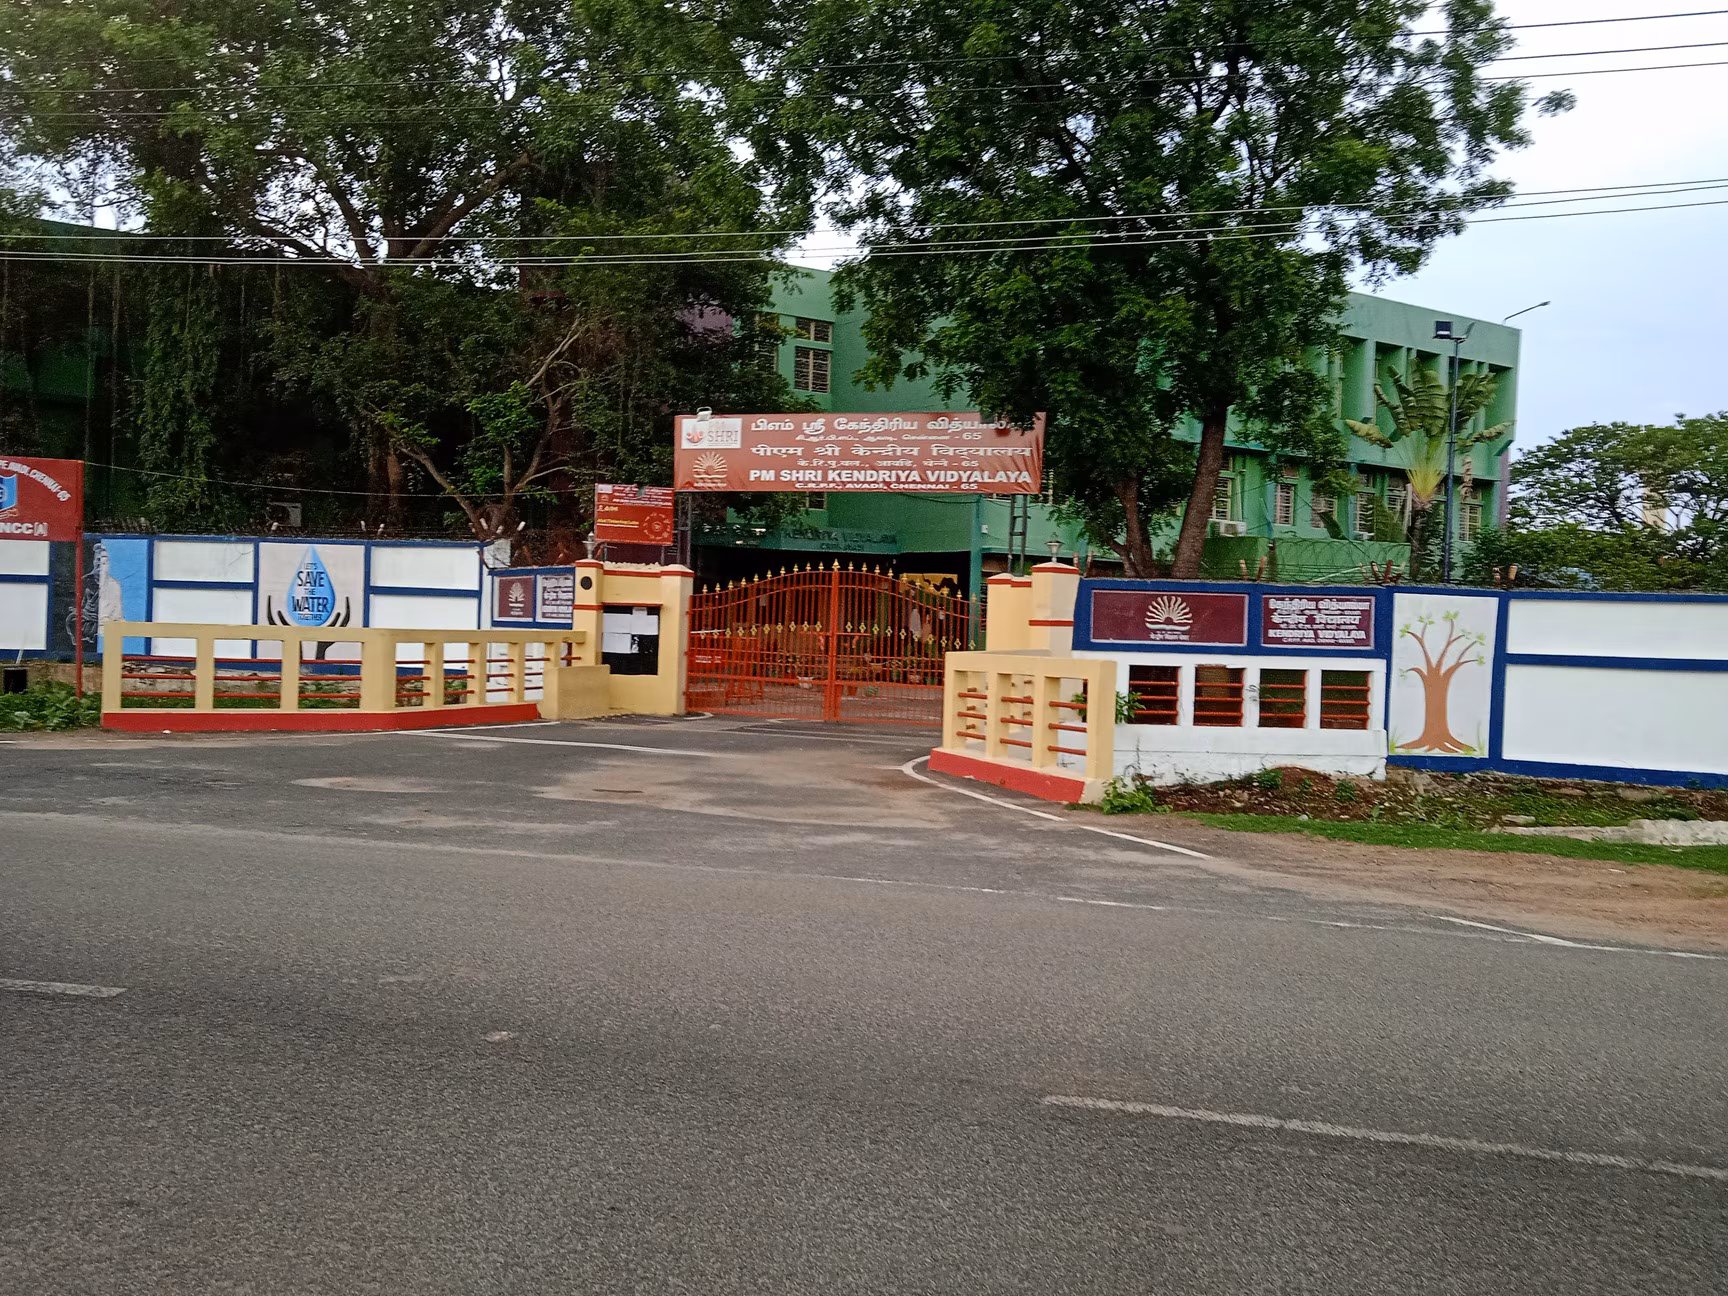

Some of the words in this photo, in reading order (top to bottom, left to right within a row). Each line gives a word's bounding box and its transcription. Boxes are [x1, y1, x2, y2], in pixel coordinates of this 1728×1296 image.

[708, 430, 738, 442] SHRI
[962, 432, 982, 441] 65
[750, 444, 804, 458] पीएम
[813, 444, 842, 456] श्री
[851, 443, 920, 456] केन्द्रीय
[930, 443, 1033, 461] विद्यालय
[961, 460, 979, 468] 65
[749, 469, 776, 481] PM
[780, 469, 822, 482] SHRI
[827, 469, 921, 482] KENDRIYA
[926, 470, 1032, 483] VIDYALAYA
[297, 570, 325, 587] SAVE
[304, 588, 316, 596] THE
[292, 595, 330, 613] WATER
